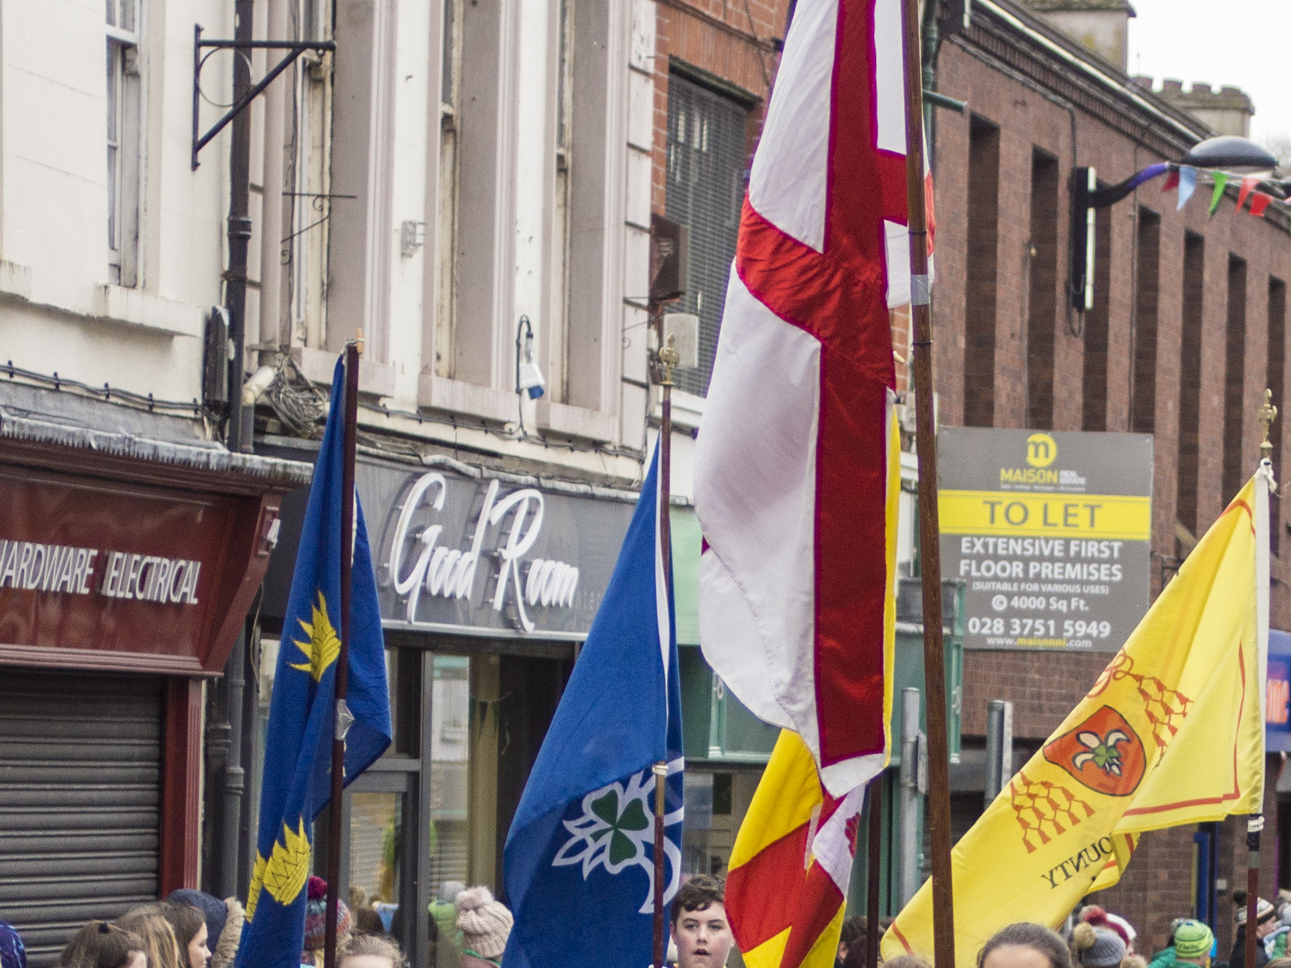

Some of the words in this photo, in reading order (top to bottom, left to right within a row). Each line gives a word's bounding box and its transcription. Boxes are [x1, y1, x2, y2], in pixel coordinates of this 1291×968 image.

[1000, 468, 1058, 484] MAISON
[983, 501, 1029, 526] TO
[1043, 502, 1102, 528] LET
[389, 472, 499, 624] Good
[490, 488, 579, 633] Room
[961, 537, 1065, 556] EXTENSIVE
[1070, 541, 1123, 558] FIRST
[104, 552, 201, 604] ELECTRICAL
[959, 559, 1024, 578] FLOOR
[1029, 562, 1123, 581] PREMISES
[972, 581, 1019, 591] (SUITABLE
[1020, 583, 1039, 592] FOR
[1041, 583, 1081, 593] VARIOUS
[1082, 585, 1109, 595] USES)
[1010, 596, 1046, 609] 4000
[1049, 596, 1067, 613] Sq
[1070, 597, 1090, 611] Ft.
[968, 617, 1004, 634] 028
[1009, 619, 1055, 636] 3751
[1063, 620, 1111, 637] 5949
[986, 637, 1092, 648] www.maisonni.com
